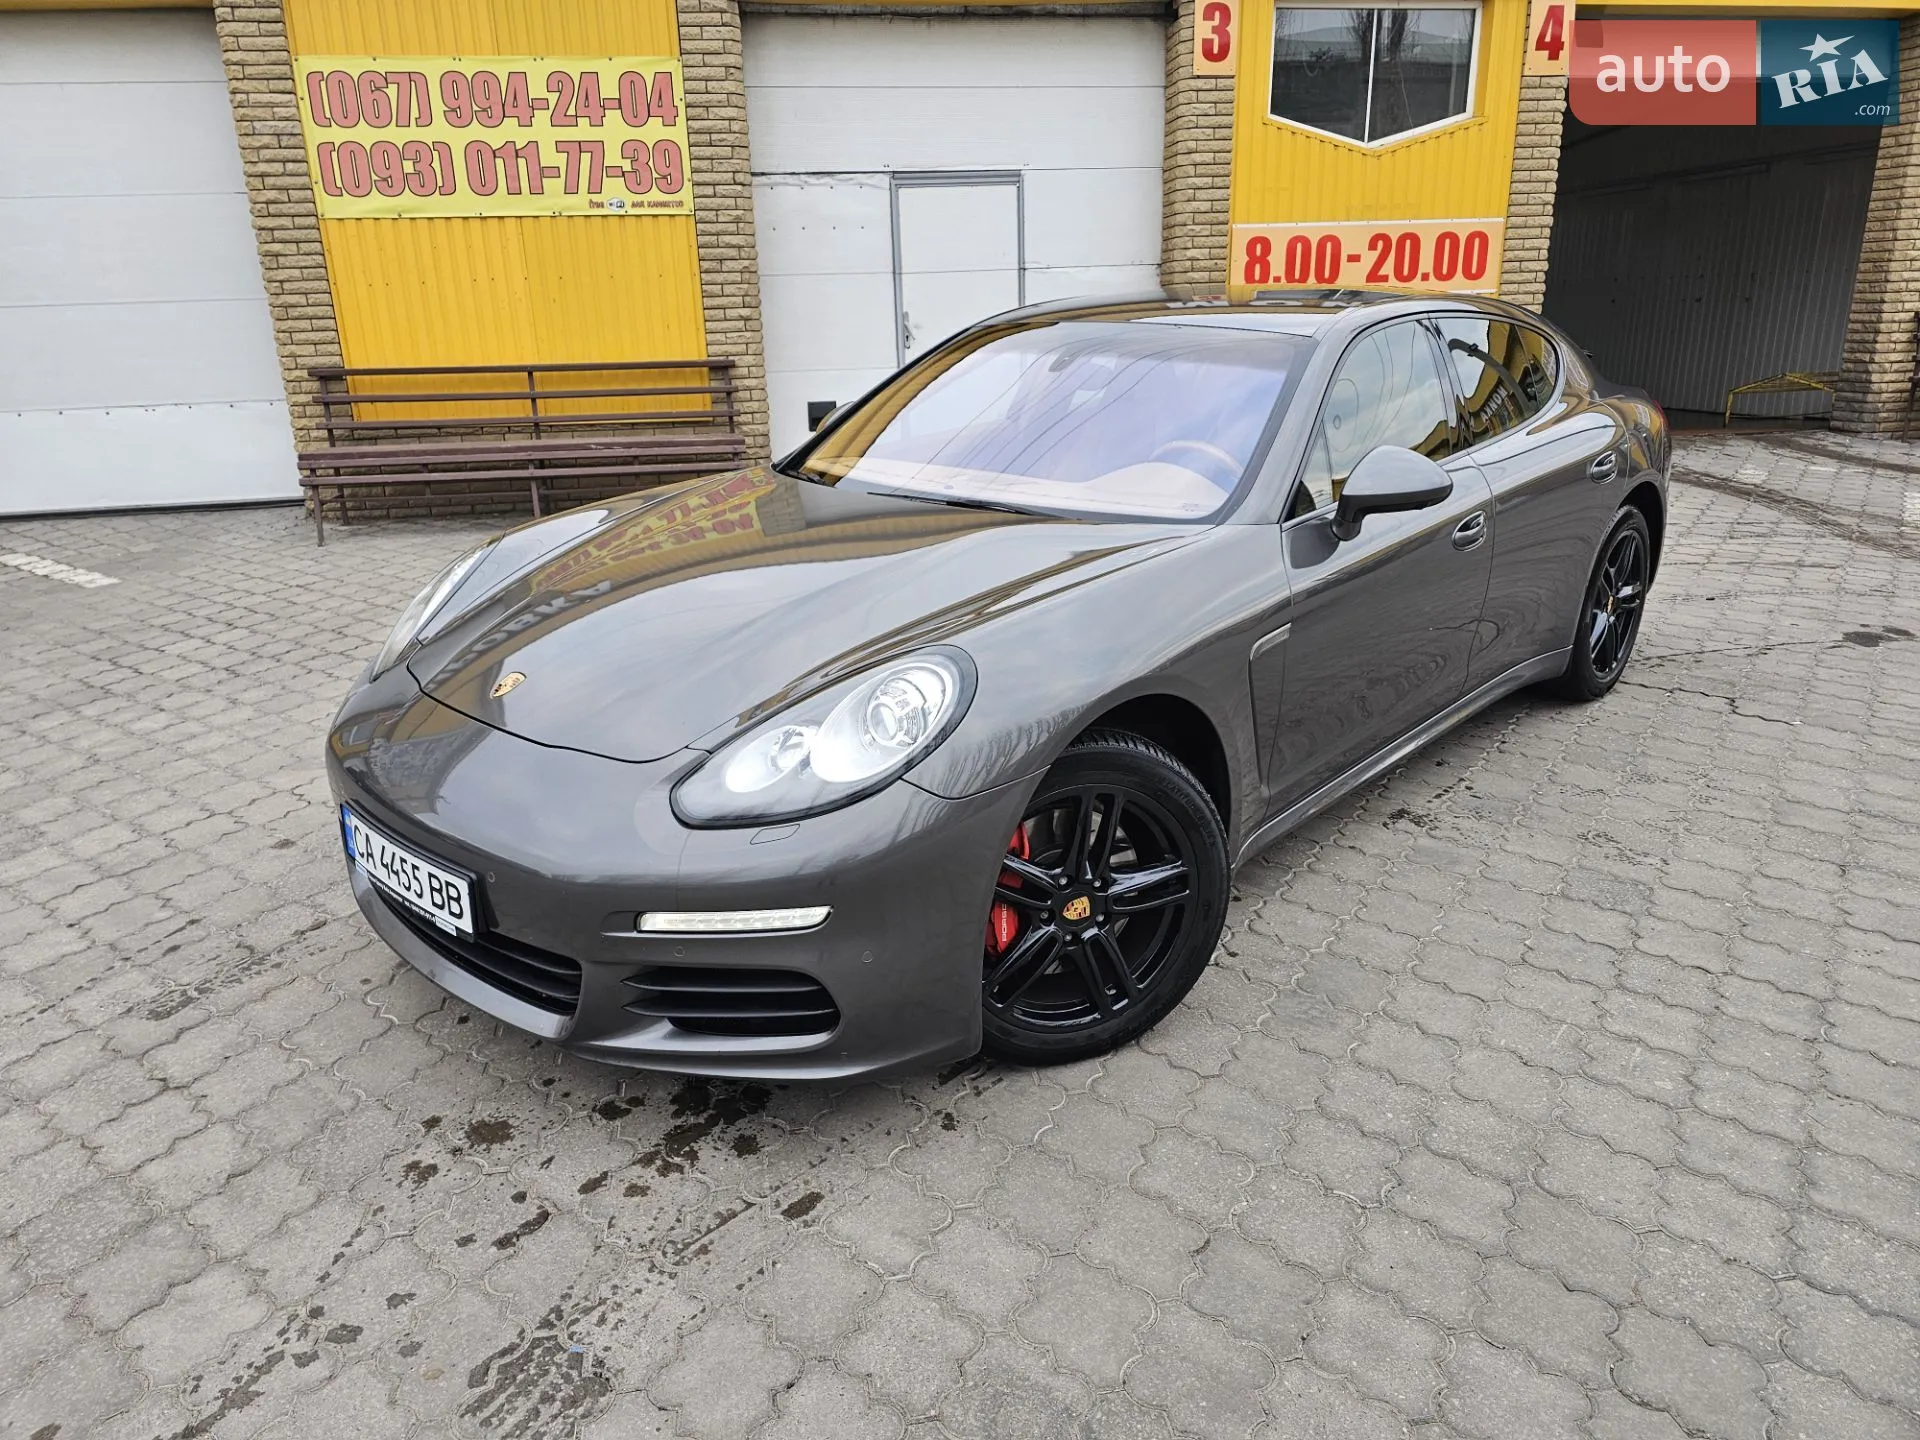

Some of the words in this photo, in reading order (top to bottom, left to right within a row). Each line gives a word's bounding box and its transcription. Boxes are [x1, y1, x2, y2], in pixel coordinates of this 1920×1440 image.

[1202, 2, 1231, 62] 3
[1535, 5, 1564, 60] 4
[306, 71, 432, 128] (067)
[440, 71, 679, 128] 994-24-04
[317, 139, 456, 197] (093)
[464, 139, 684, 197] 011-77-39
[1244, 230, 1489, 284] 8.00-20.00
[354, 824, 377, 870] CA
[380, 845, 424, 899] 4455
[427, 871, 464, 920] BB
